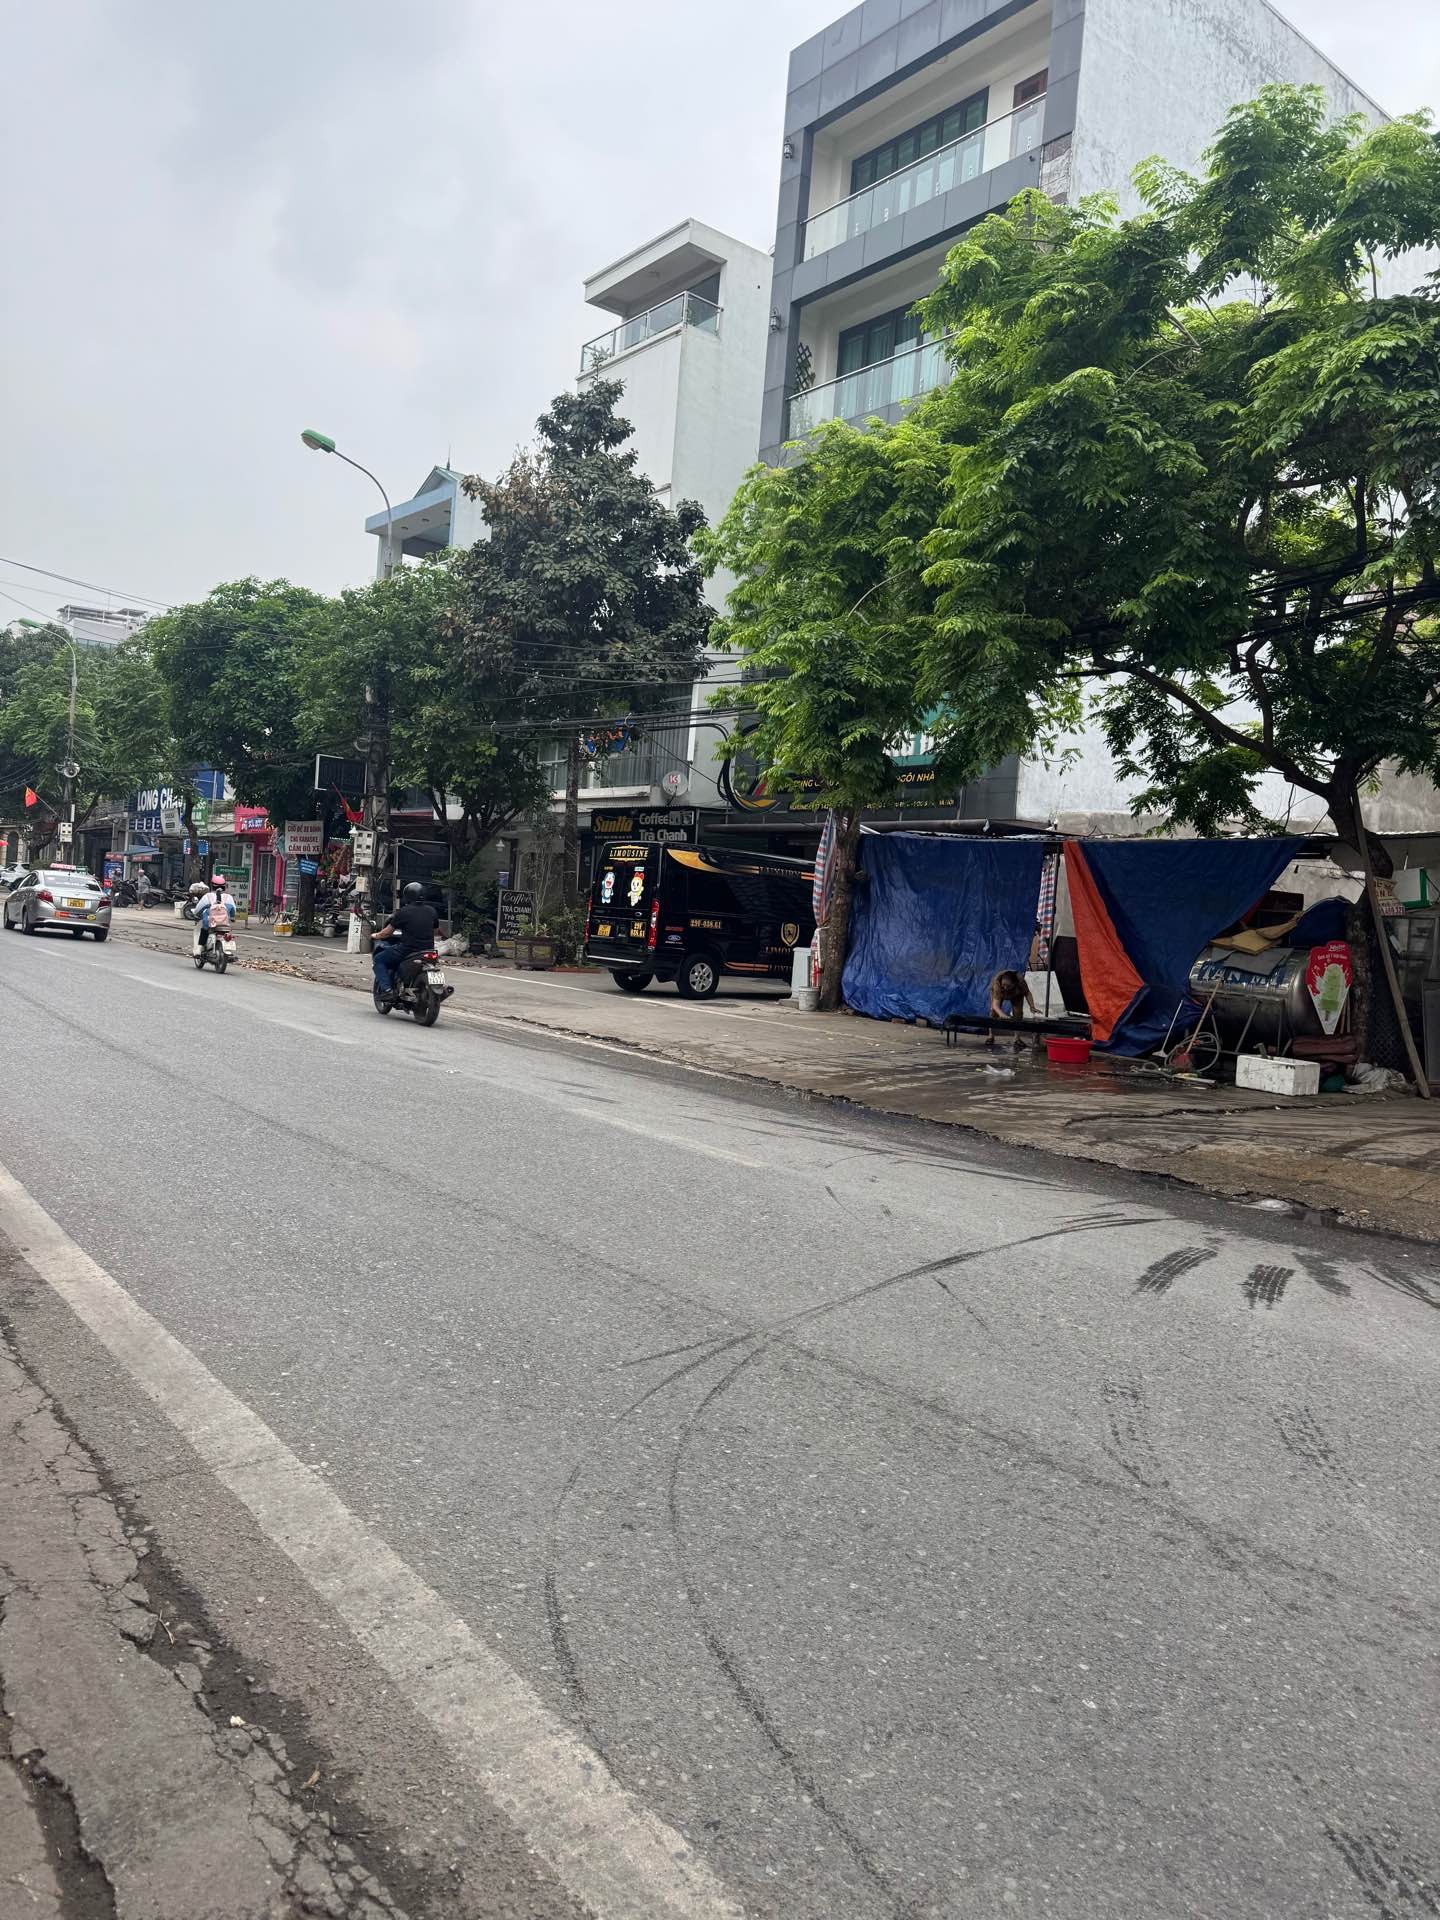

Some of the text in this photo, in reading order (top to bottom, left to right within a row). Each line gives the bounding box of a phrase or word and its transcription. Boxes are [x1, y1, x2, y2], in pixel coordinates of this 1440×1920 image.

[137, 789, 159, 812] LONG
[639, 813, 672, 825] Coffee
[656, 828, 687, 841] Chanh
[609, 849, 649, 858] LIMOUSINE
